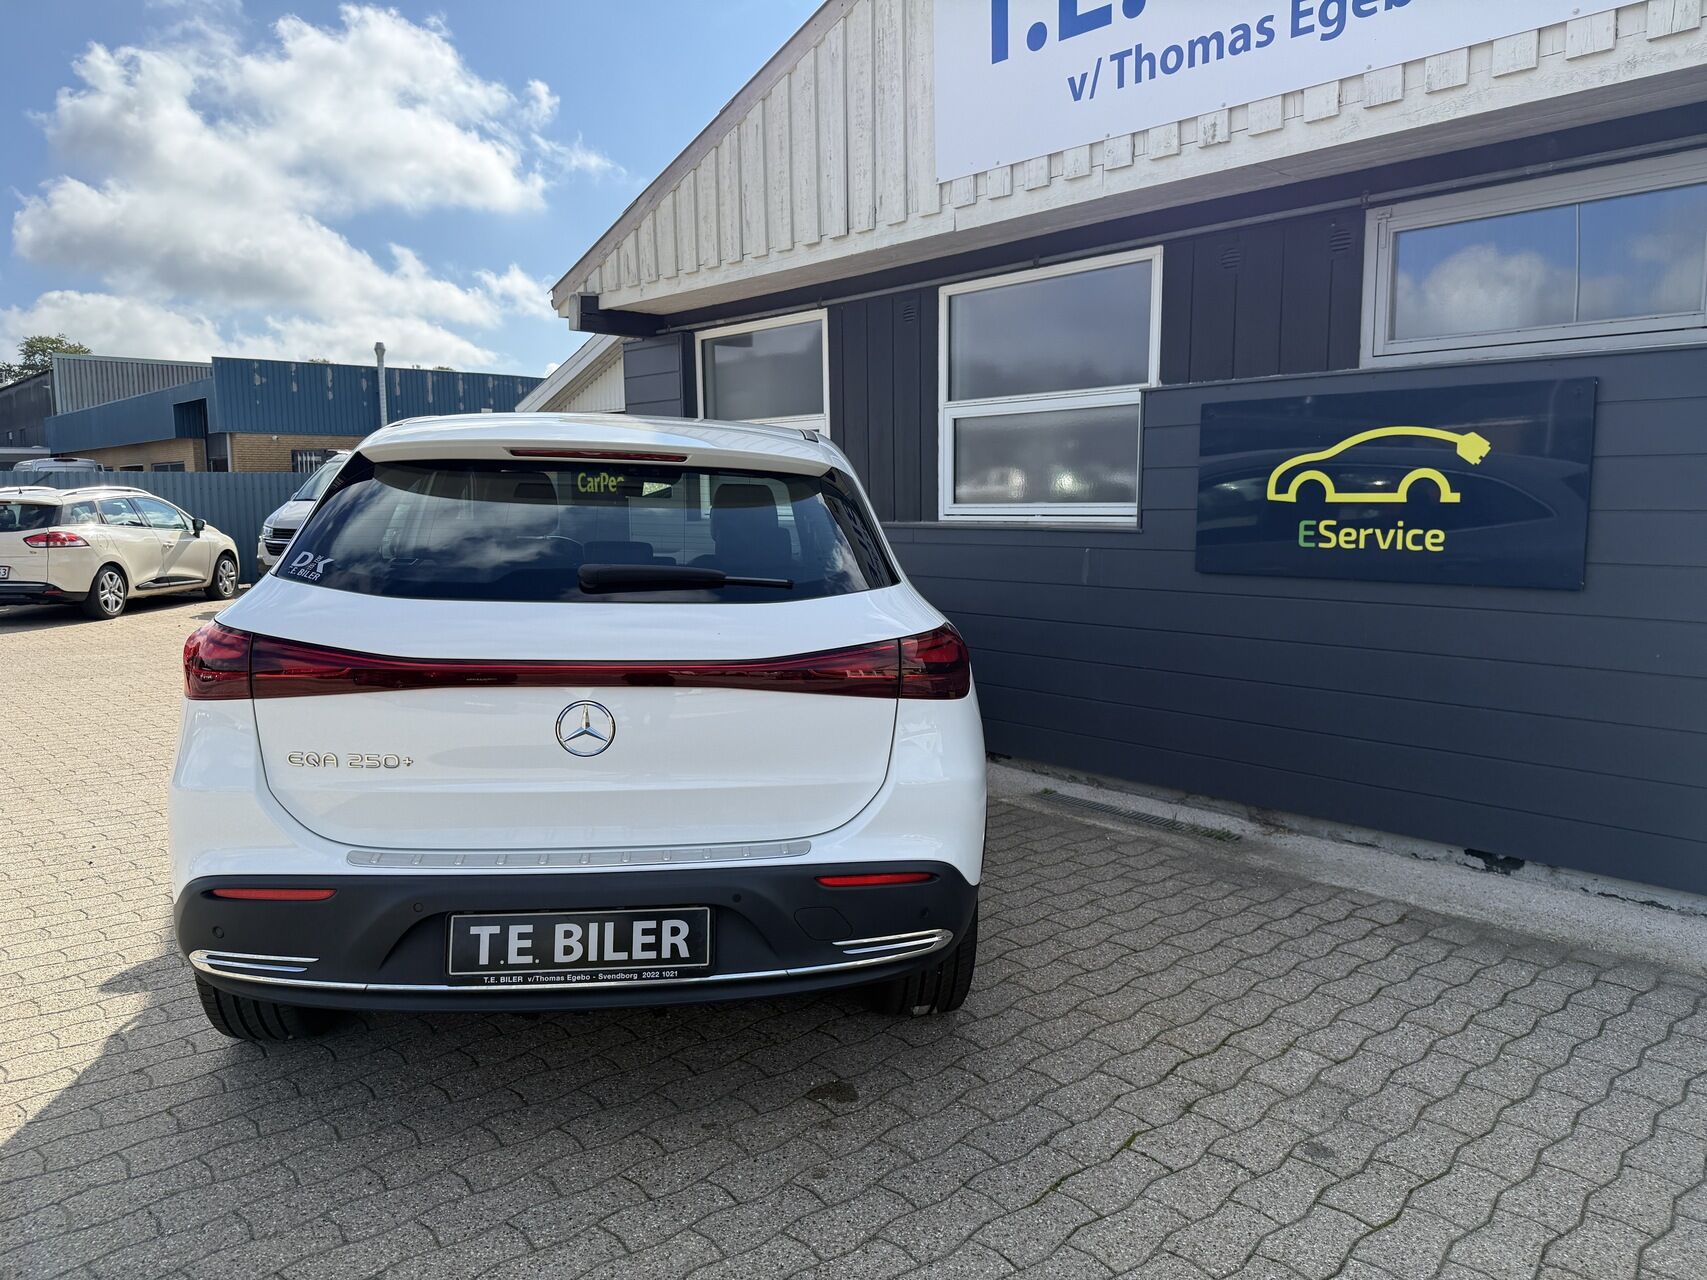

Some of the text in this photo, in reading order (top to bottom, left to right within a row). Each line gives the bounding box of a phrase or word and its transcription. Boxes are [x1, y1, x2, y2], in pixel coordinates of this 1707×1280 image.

[1110, 14, 1276, 89] Thomas
[1290, 0, 1411, 41] Ege
[577, 472, 625, 493] CarPe
[1298, 519, 1446, 552] EService
[297, 568, 321, 581] BILER
[286, 751, 414, 768] EQA 250+
[470, 919, 690, 966] T.E. BILER
[483, 976, 498, 984] T.E.
[566, 974, 591, 983] Egebo
[598, 972, 638, 980] Svendborg
